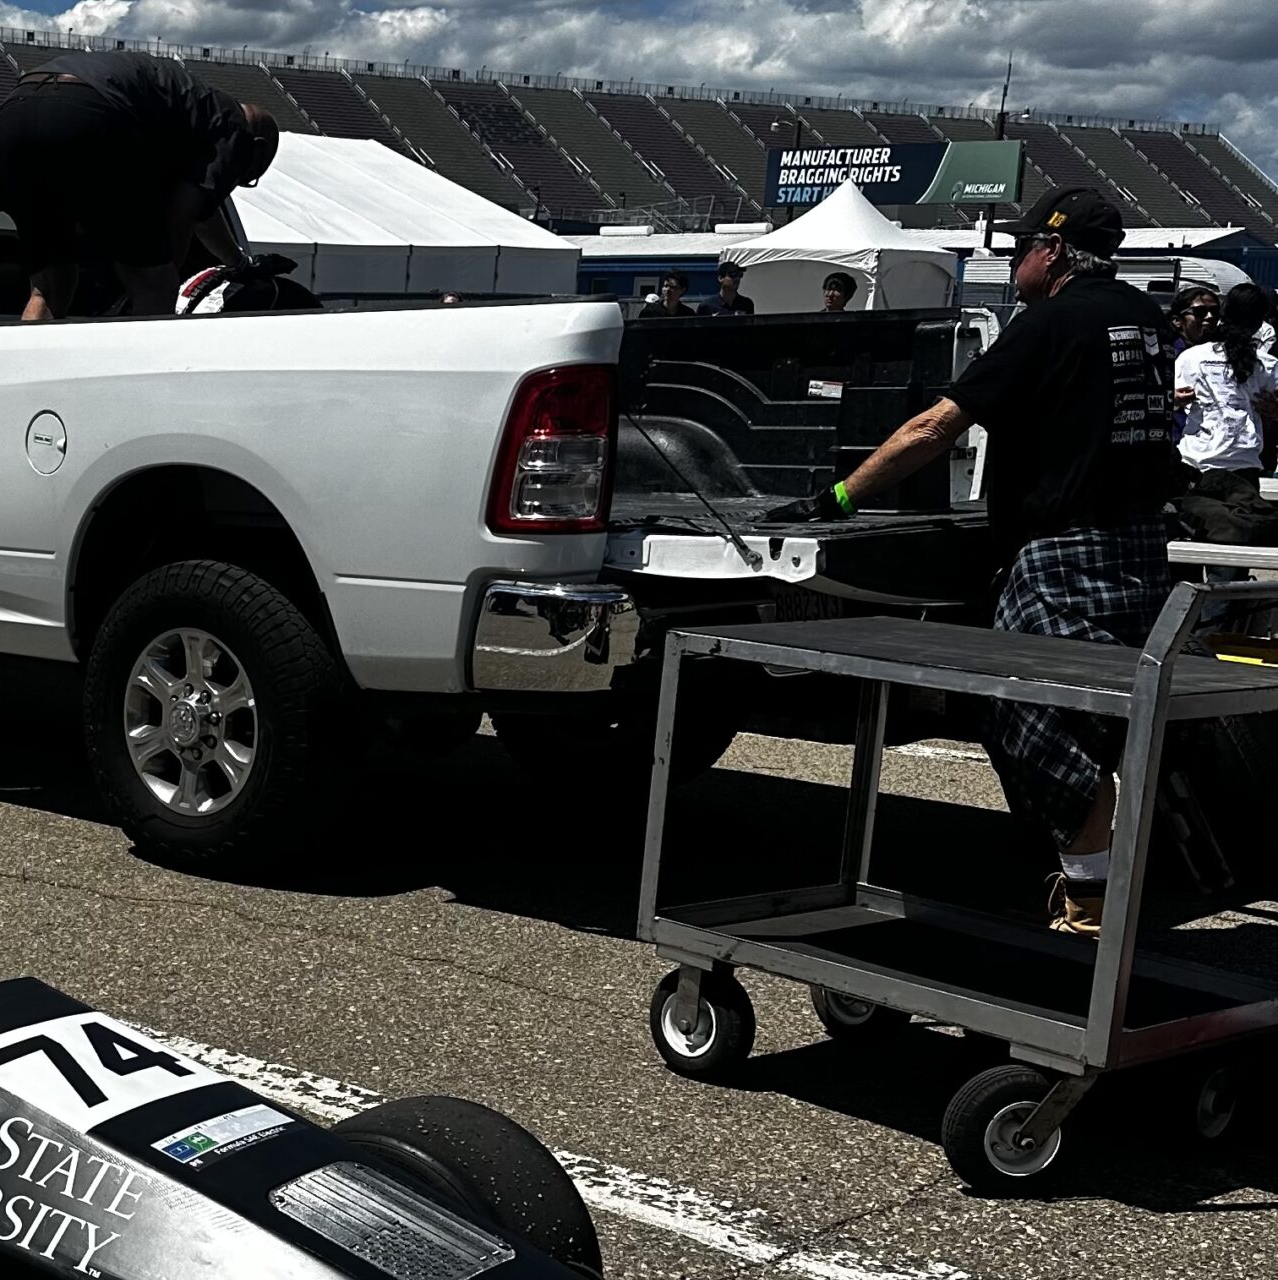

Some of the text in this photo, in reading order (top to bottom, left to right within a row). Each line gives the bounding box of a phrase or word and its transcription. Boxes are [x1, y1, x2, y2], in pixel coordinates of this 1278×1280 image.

[780, 148, 891, 167] MANUFACTURER
[778, 166, 901, 185] BRAGGING RIGHTS
[777, 187, 821, 203] START
[963, 184, 1006, 195] MICHIGAN
